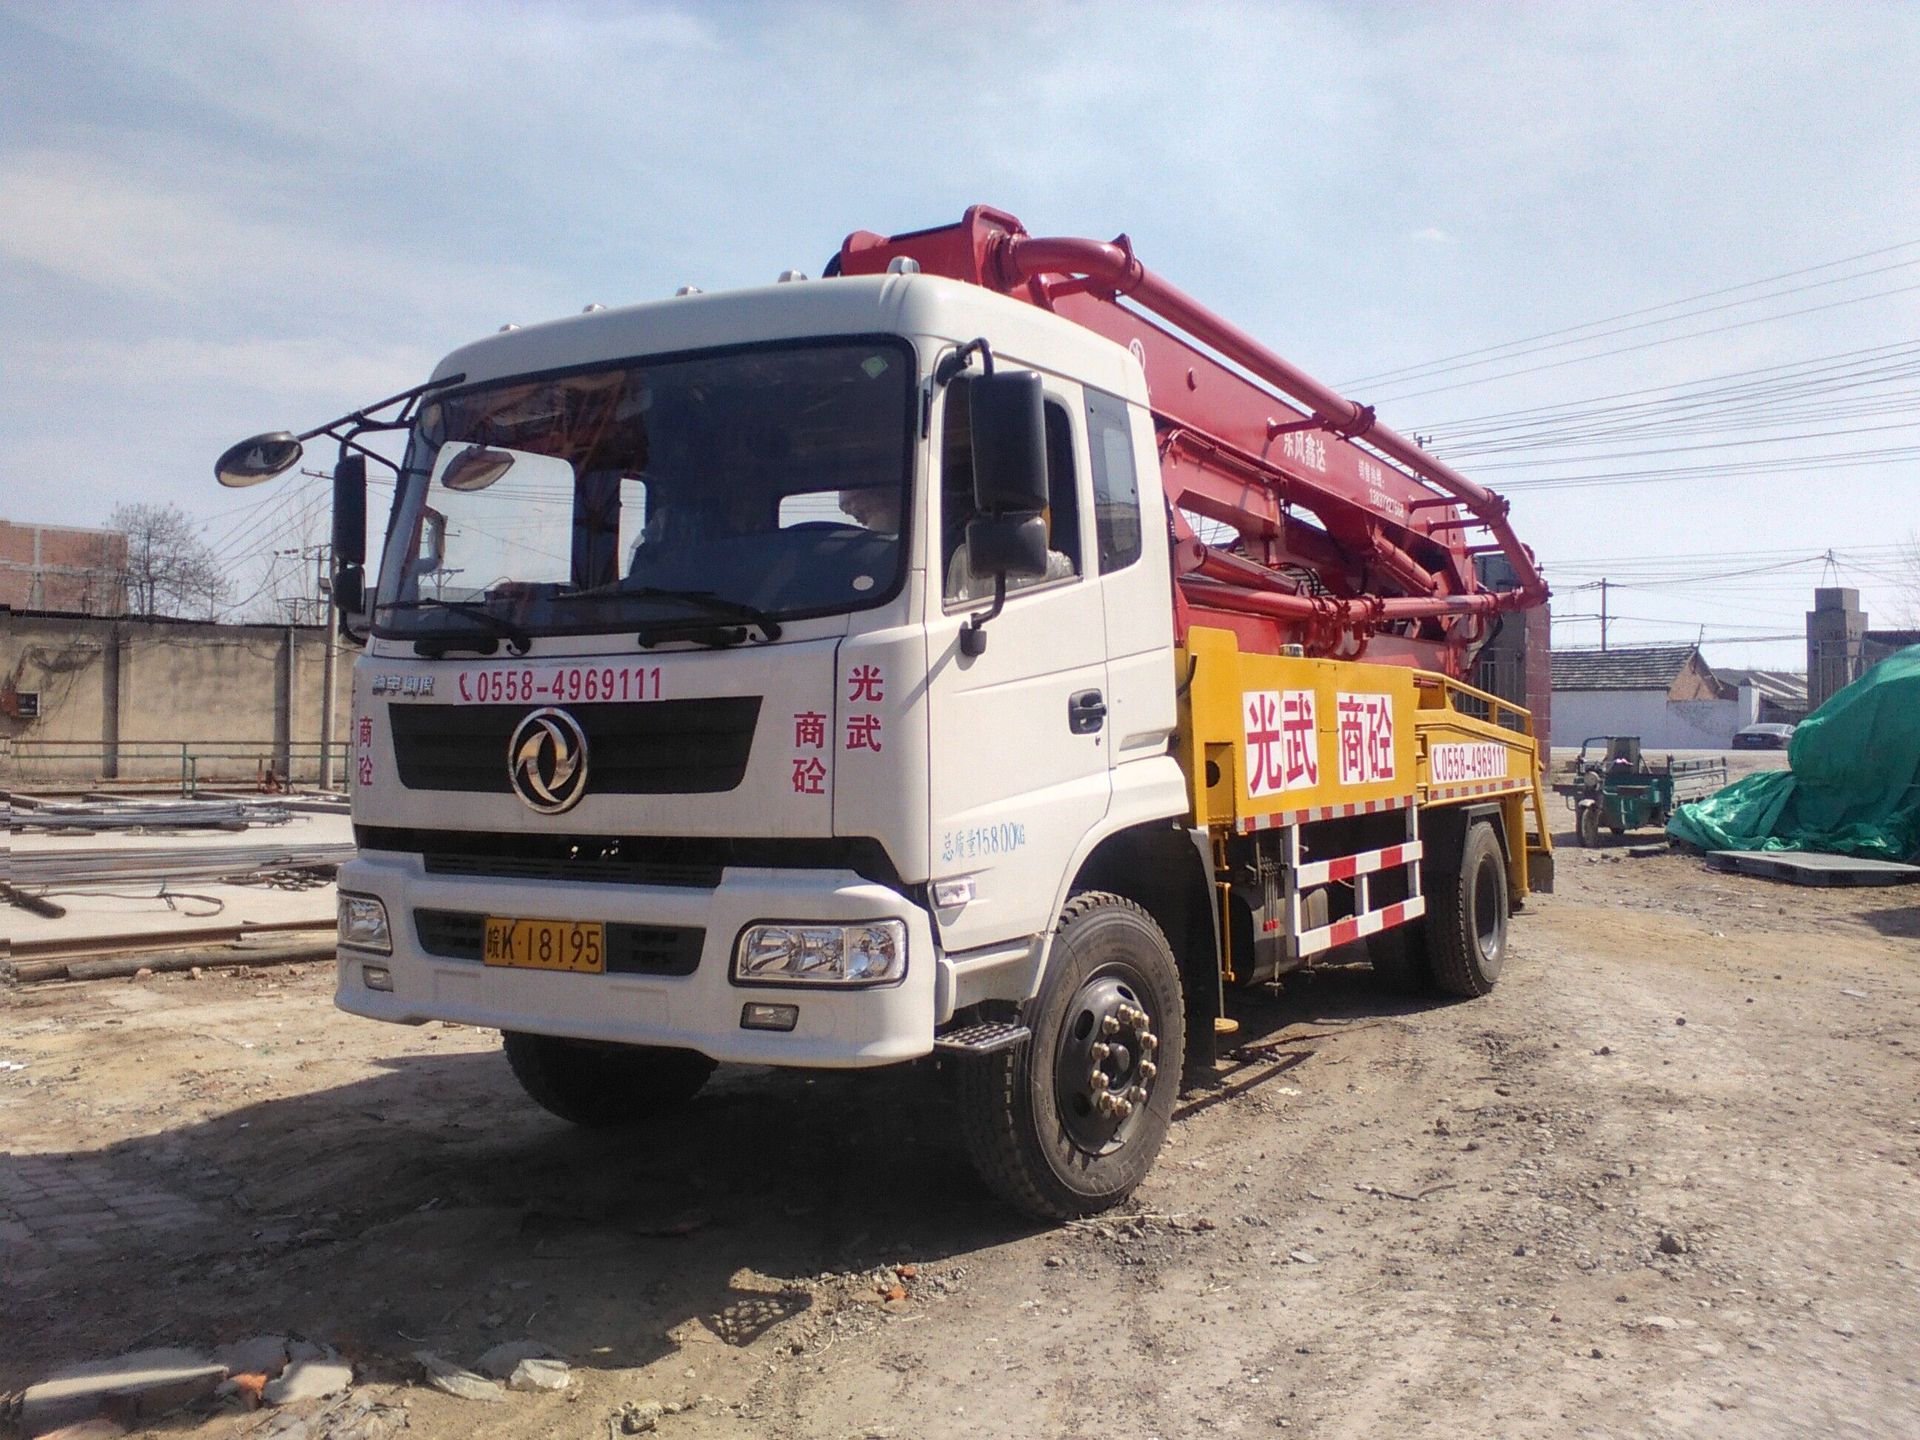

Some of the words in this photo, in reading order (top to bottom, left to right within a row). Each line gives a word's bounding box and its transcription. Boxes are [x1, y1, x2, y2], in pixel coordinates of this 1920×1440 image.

[477, 667, 661, 702] 0558-4969111
[846, 664, 884, 752] 光武
[359, 715, 373, 786] 商砼
[792, 711, 827, 794] 商砼
[1246, 692, 1317, 795] 光武
[1338, 695, 1394, 782] 商砼
[1441, 746, 1506, 781] 0558-4969111
